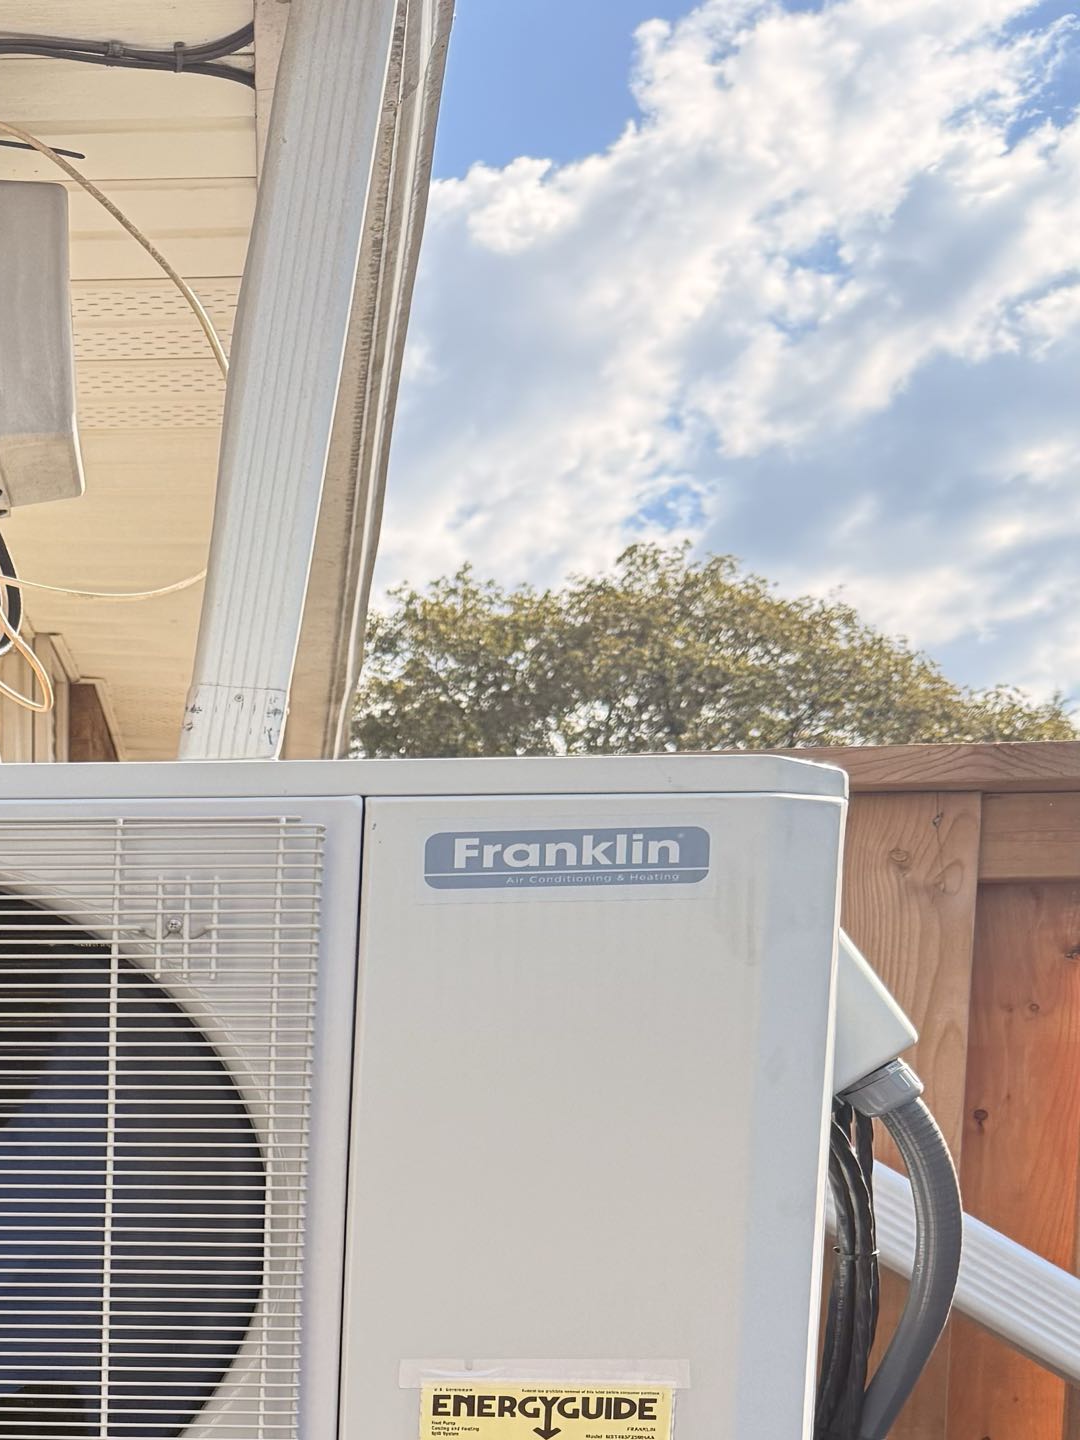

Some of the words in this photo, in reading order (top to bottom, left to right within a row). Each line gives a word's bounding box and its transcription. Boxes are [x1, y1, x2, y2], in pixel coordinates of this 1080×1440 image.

[453, 832, 680, 870] Franklin
[505, 876, 524, 885] Air
[528, 873, 612, 885] Conditioning
[615, 873, 625, 882] &
[629, 872, 680, 883] Heating
[432, 1394, 657, 1421] ENERGYGUIDE
